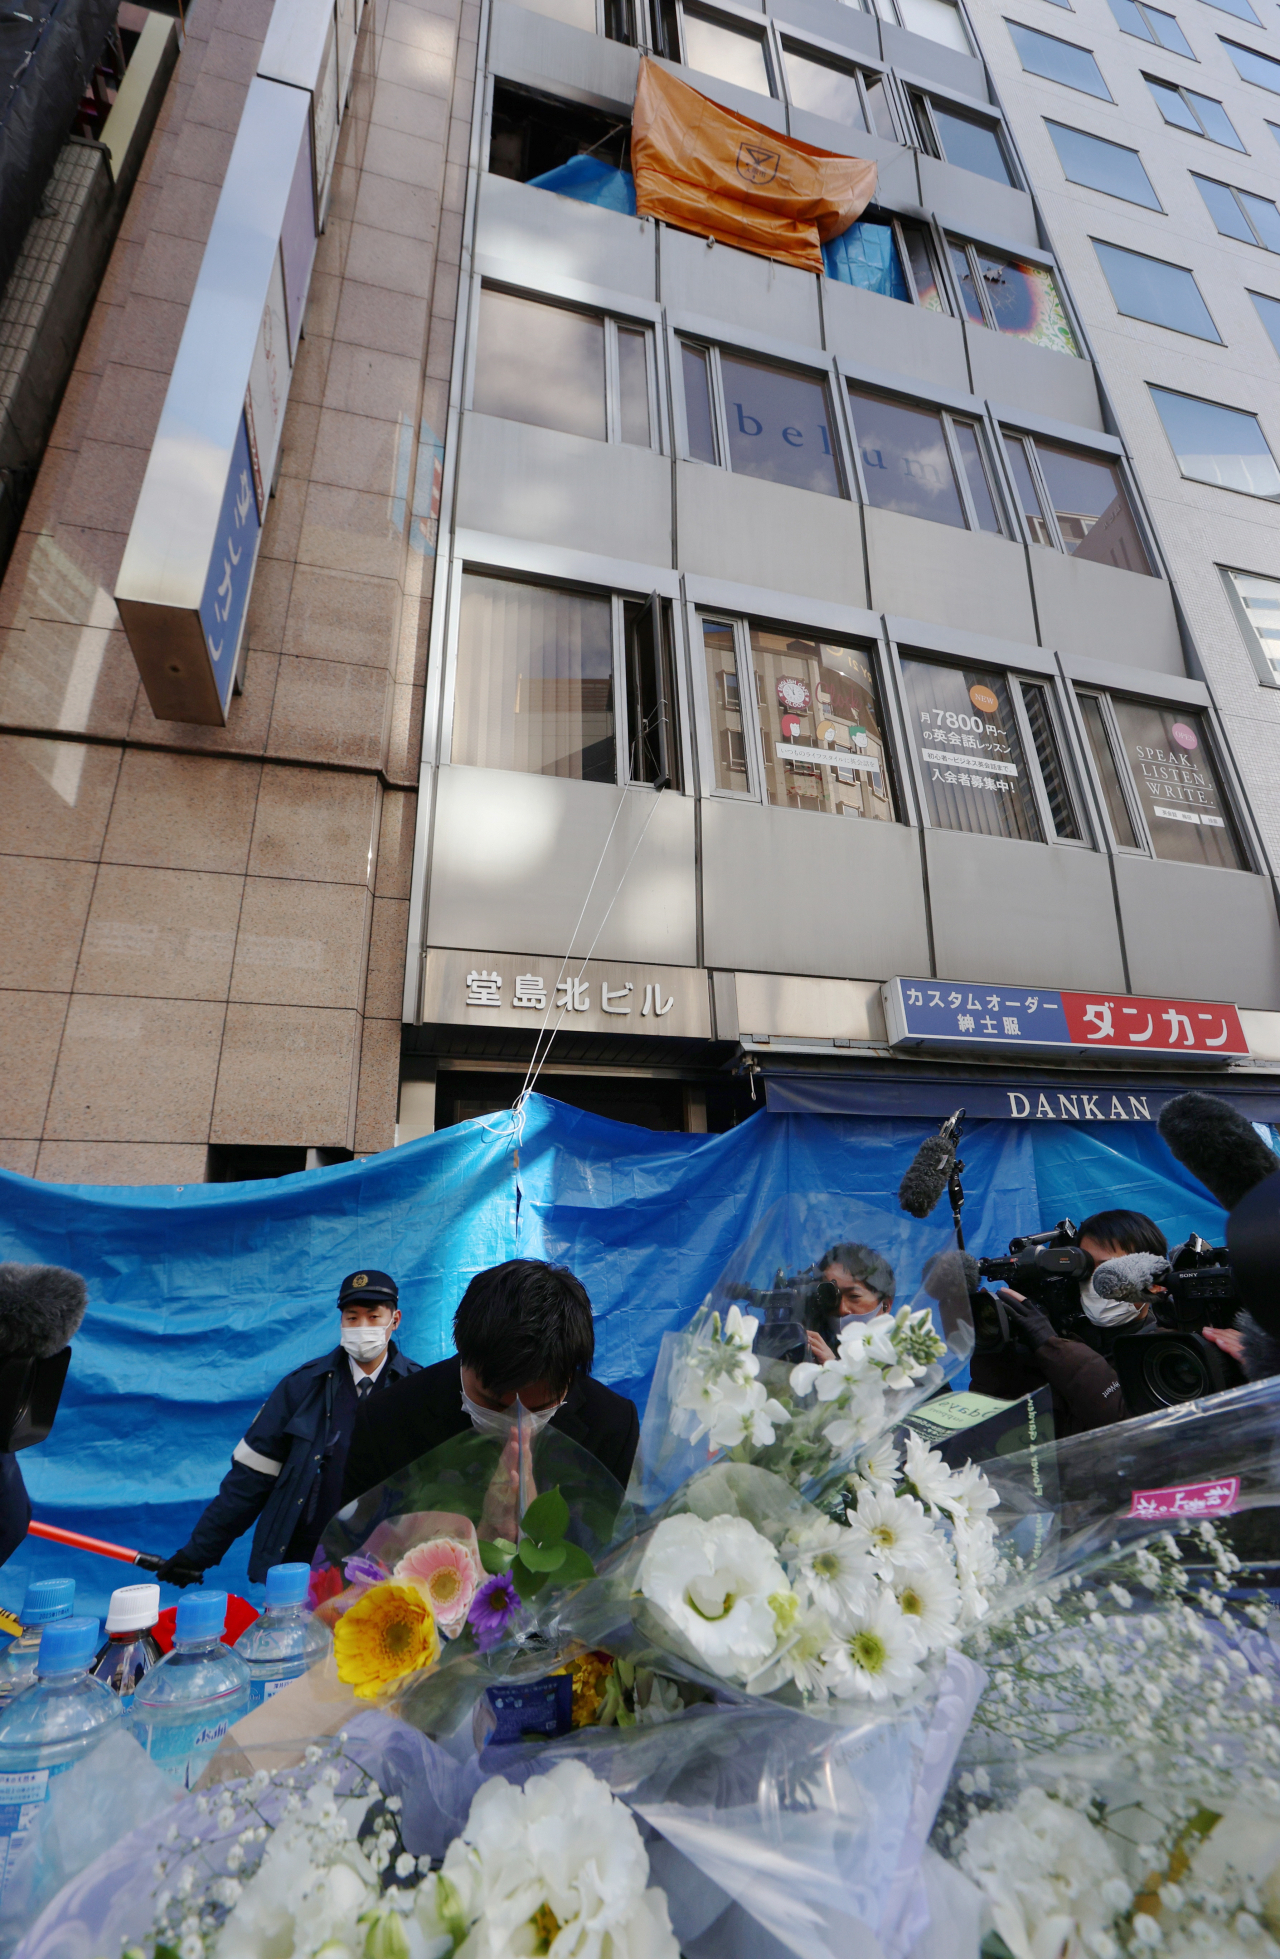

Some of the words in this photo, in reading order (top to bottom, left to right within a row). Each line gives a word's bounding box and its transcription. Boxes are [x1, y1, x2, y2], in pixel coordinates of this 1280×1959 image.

[974, 693, 994, 705] NEW
[922, 728, 1012, 754] の英会話レッスン
[1174, 730, 1196, 742] OPEN
[1135, 745, 1198, 769] SPEAK,
[1141, 763, 1213, 789] LISTEN,
[1146, 781, 1215, 805] WRITE.
[466, 969, 675, 1017] 堂島北ビル
[906, 987, 1059, 1015] カスタムオーダー
[956, 1013, 1022, 1036] 紳士服
[1082, 1001, 1229, 1047] ダンカン
[1006, 1091, 1152, 1121] DANKAN
[195, 1720, 228, 1746] Asahi
